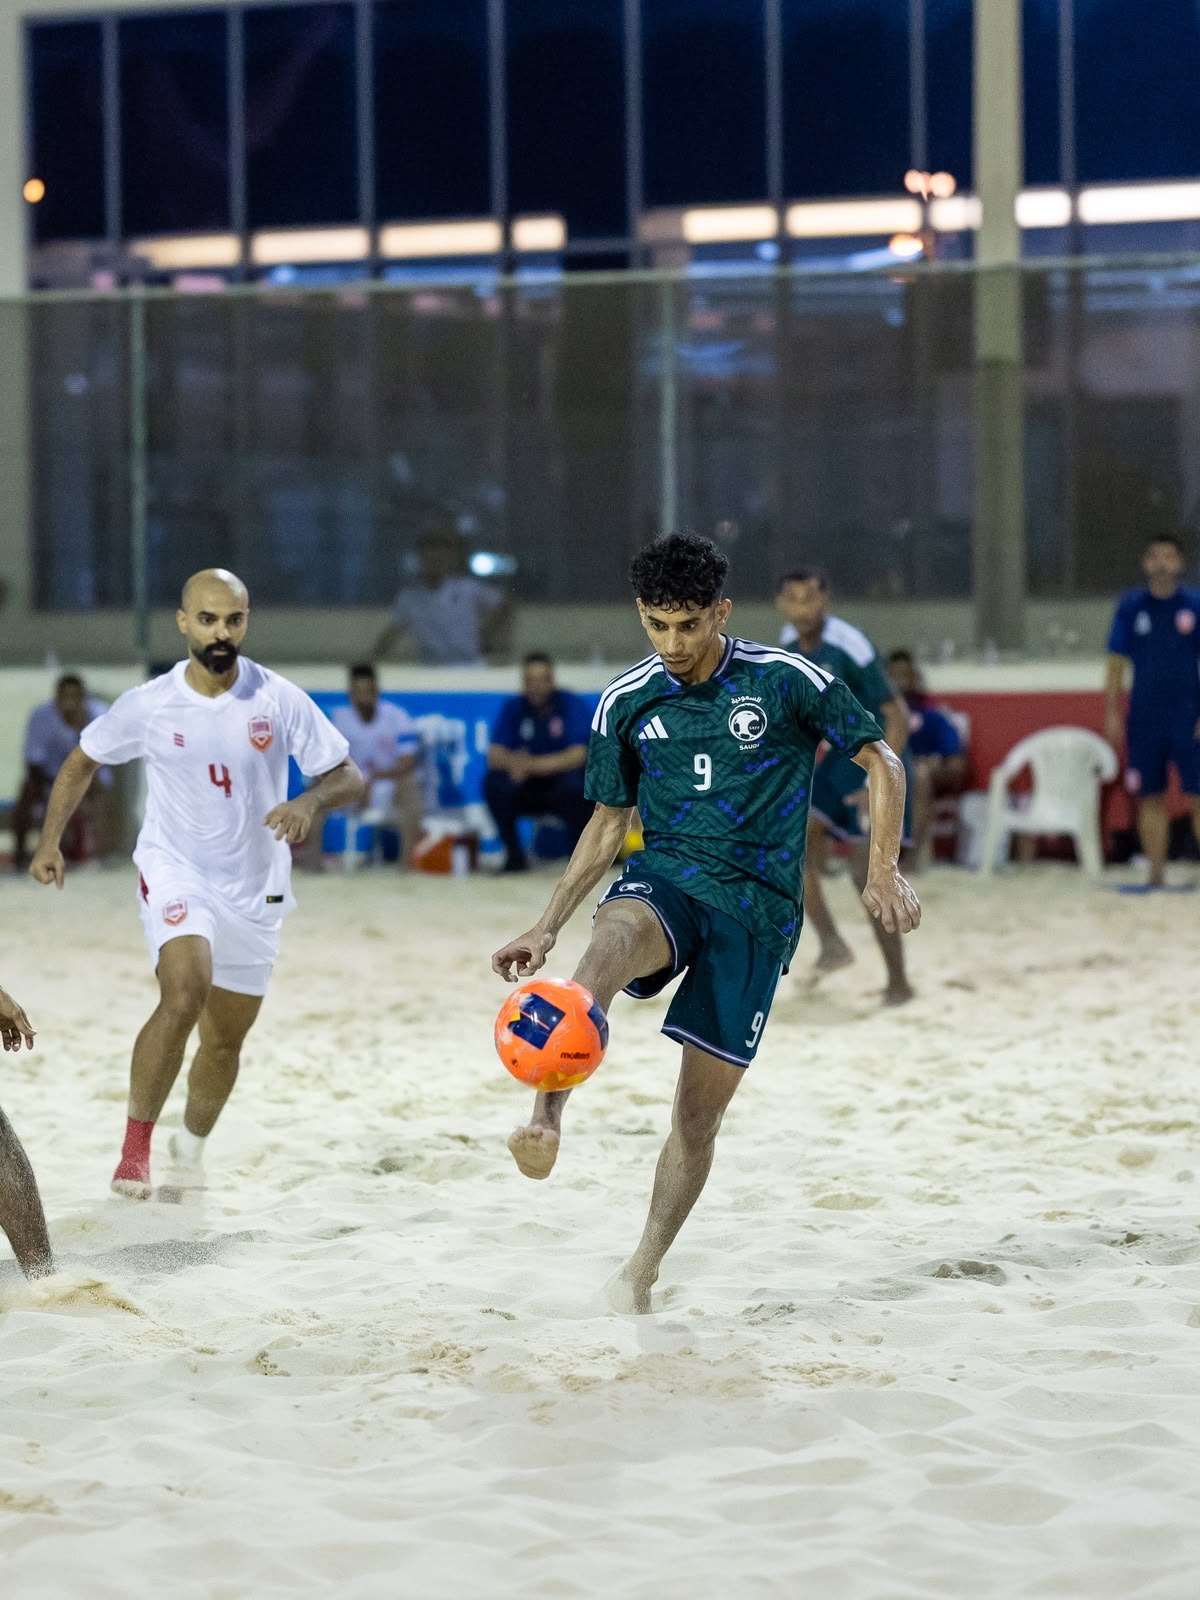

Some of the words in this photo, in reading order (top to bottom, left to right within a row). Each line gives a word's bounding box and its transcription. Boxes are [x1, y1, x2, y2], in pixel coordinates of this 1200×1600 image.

[731, 695, 762, 704] السعودية
[739, 743, 760, 751] SAUDI
[208, 763, 232, 799] 4
[693, 753, 712, 791] 9
[745, 1011, 764, 1048] 9
